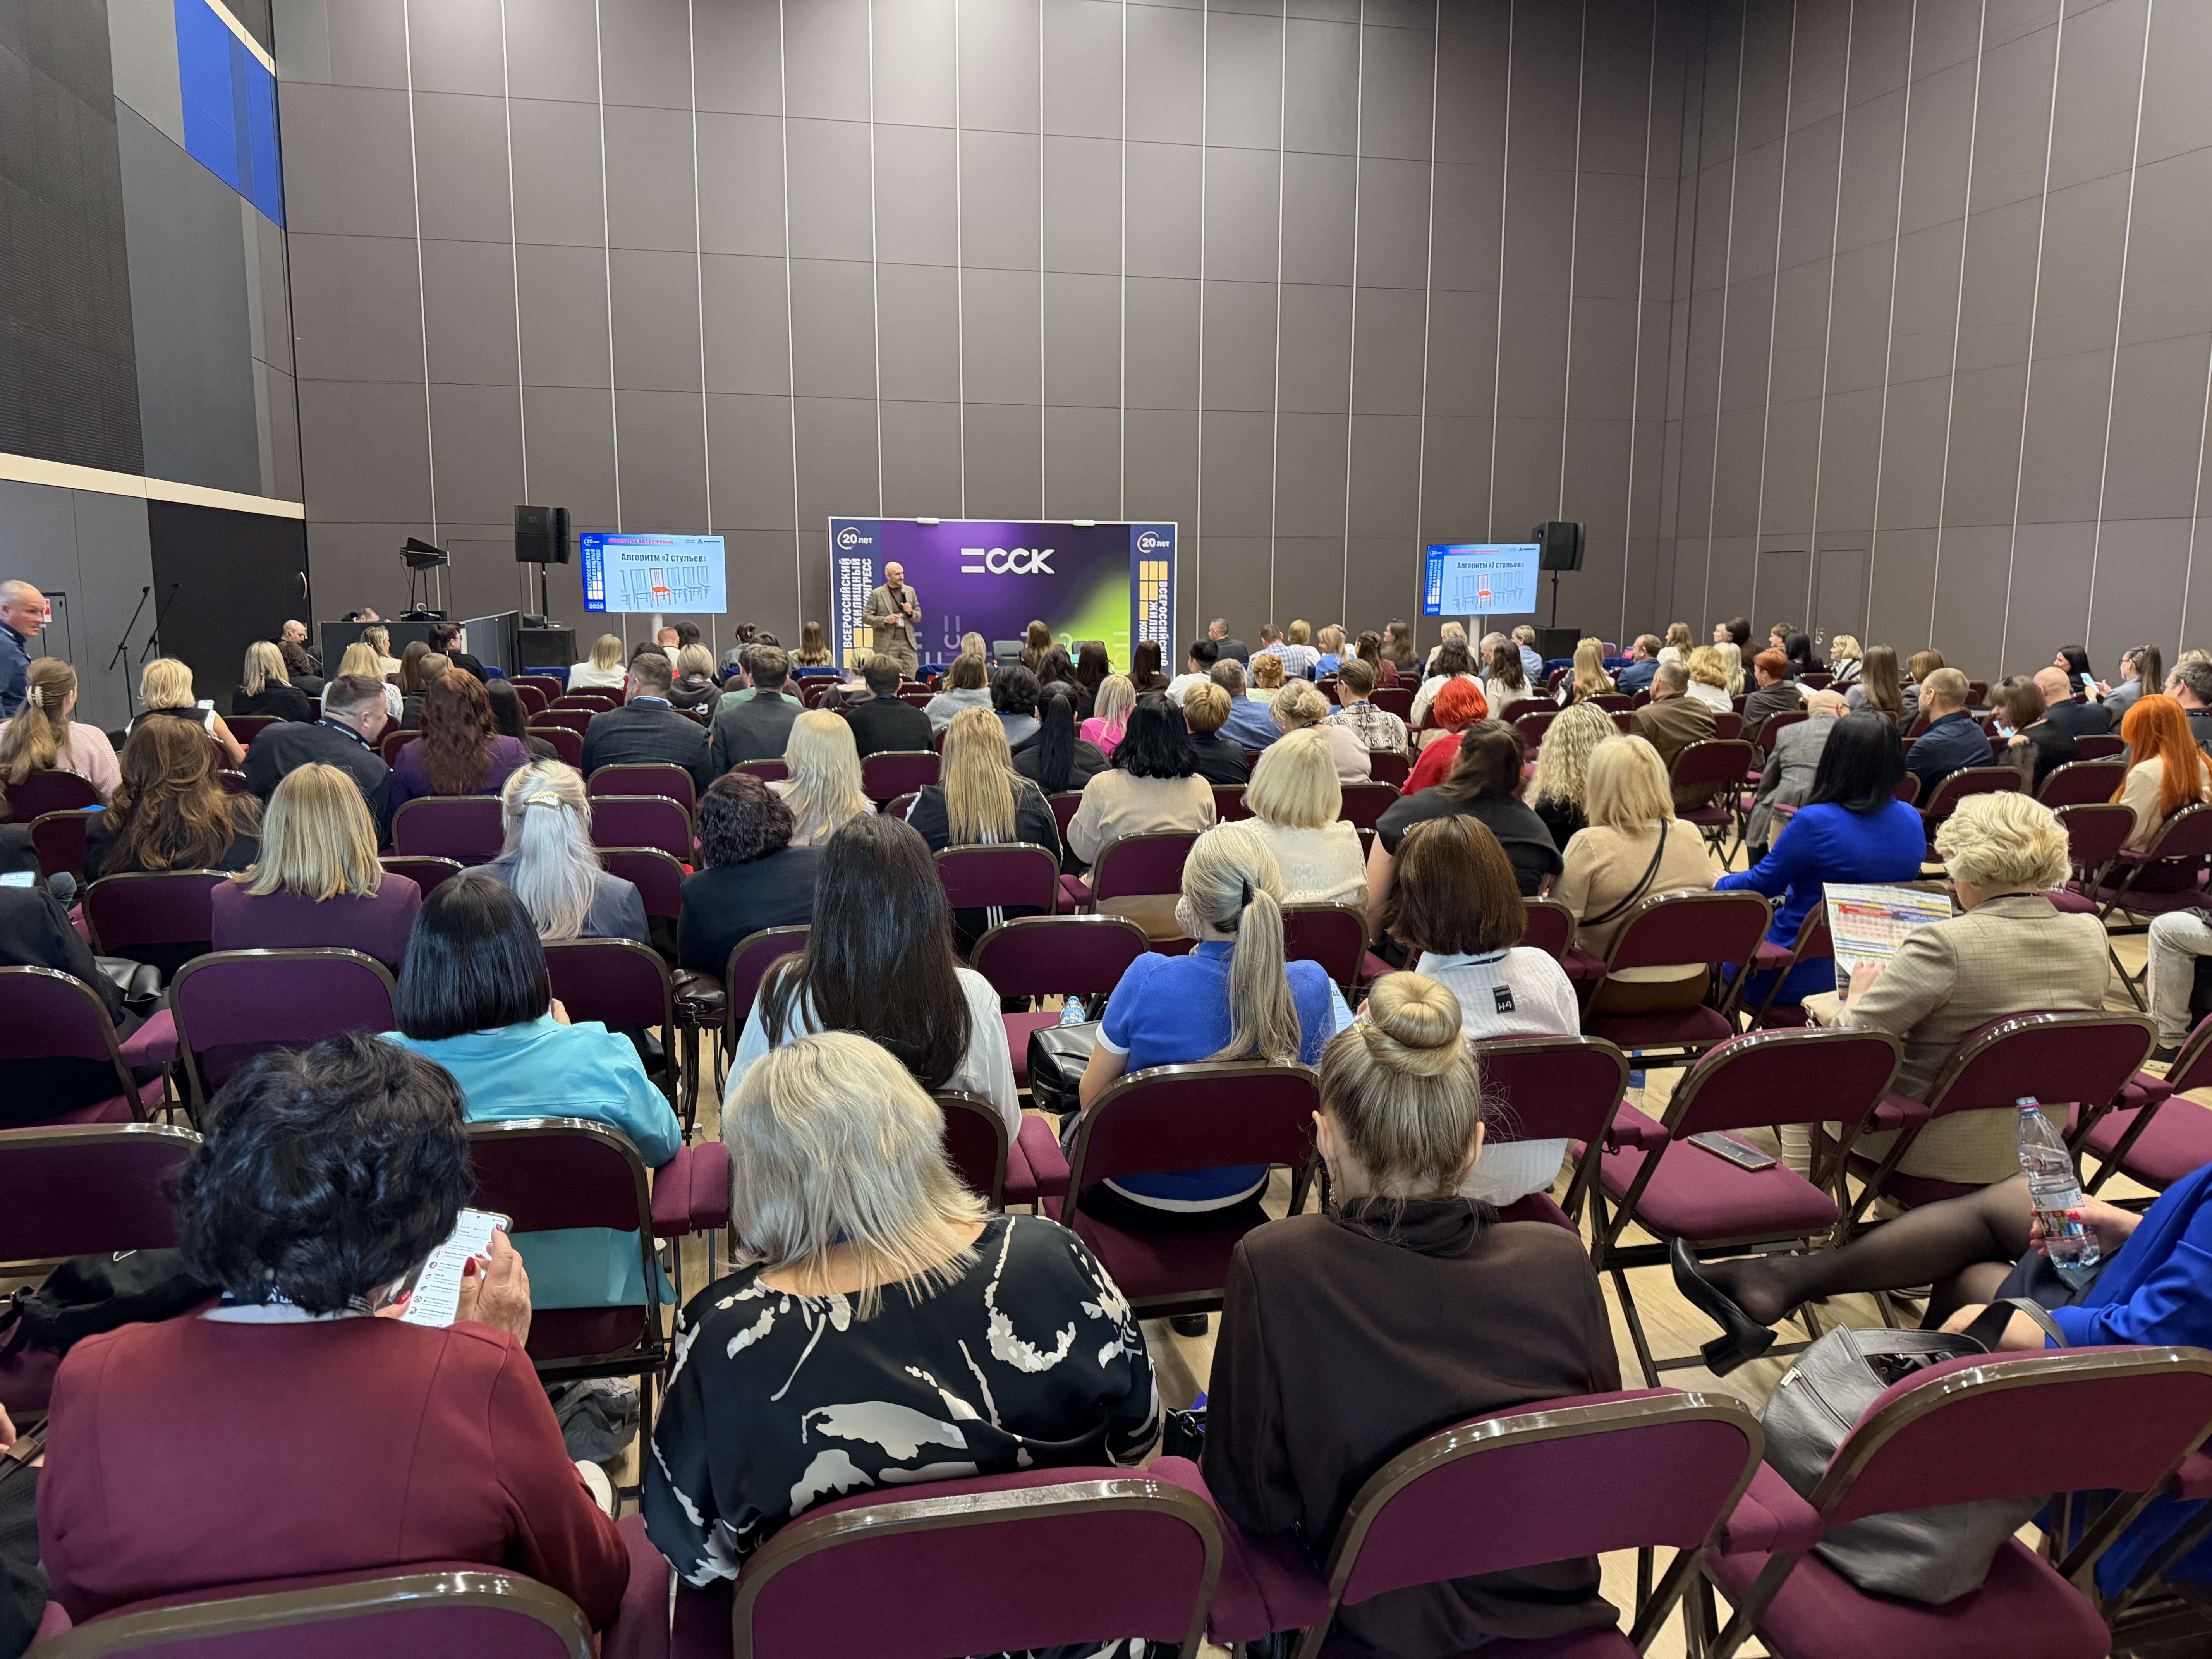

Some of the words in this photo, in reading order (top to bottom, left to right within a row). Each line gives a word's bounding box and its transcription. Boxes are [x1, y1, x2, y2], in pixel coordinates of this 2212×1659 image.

[621, 553, 660, 562] Алгоритм
[671, 554, 707, 562] стульев»
[842, 534, 857, 544] 20
[1142, 538, 1156, 548] 20
[838, 558, 852, 648] ВСЕРОССИЙСКИЙ
[850, 558, 863, 627] ЖИЛИЩНЫЙ
[1158, 581, 1169, 666] ВСЕРОССИЙСКИЙ
